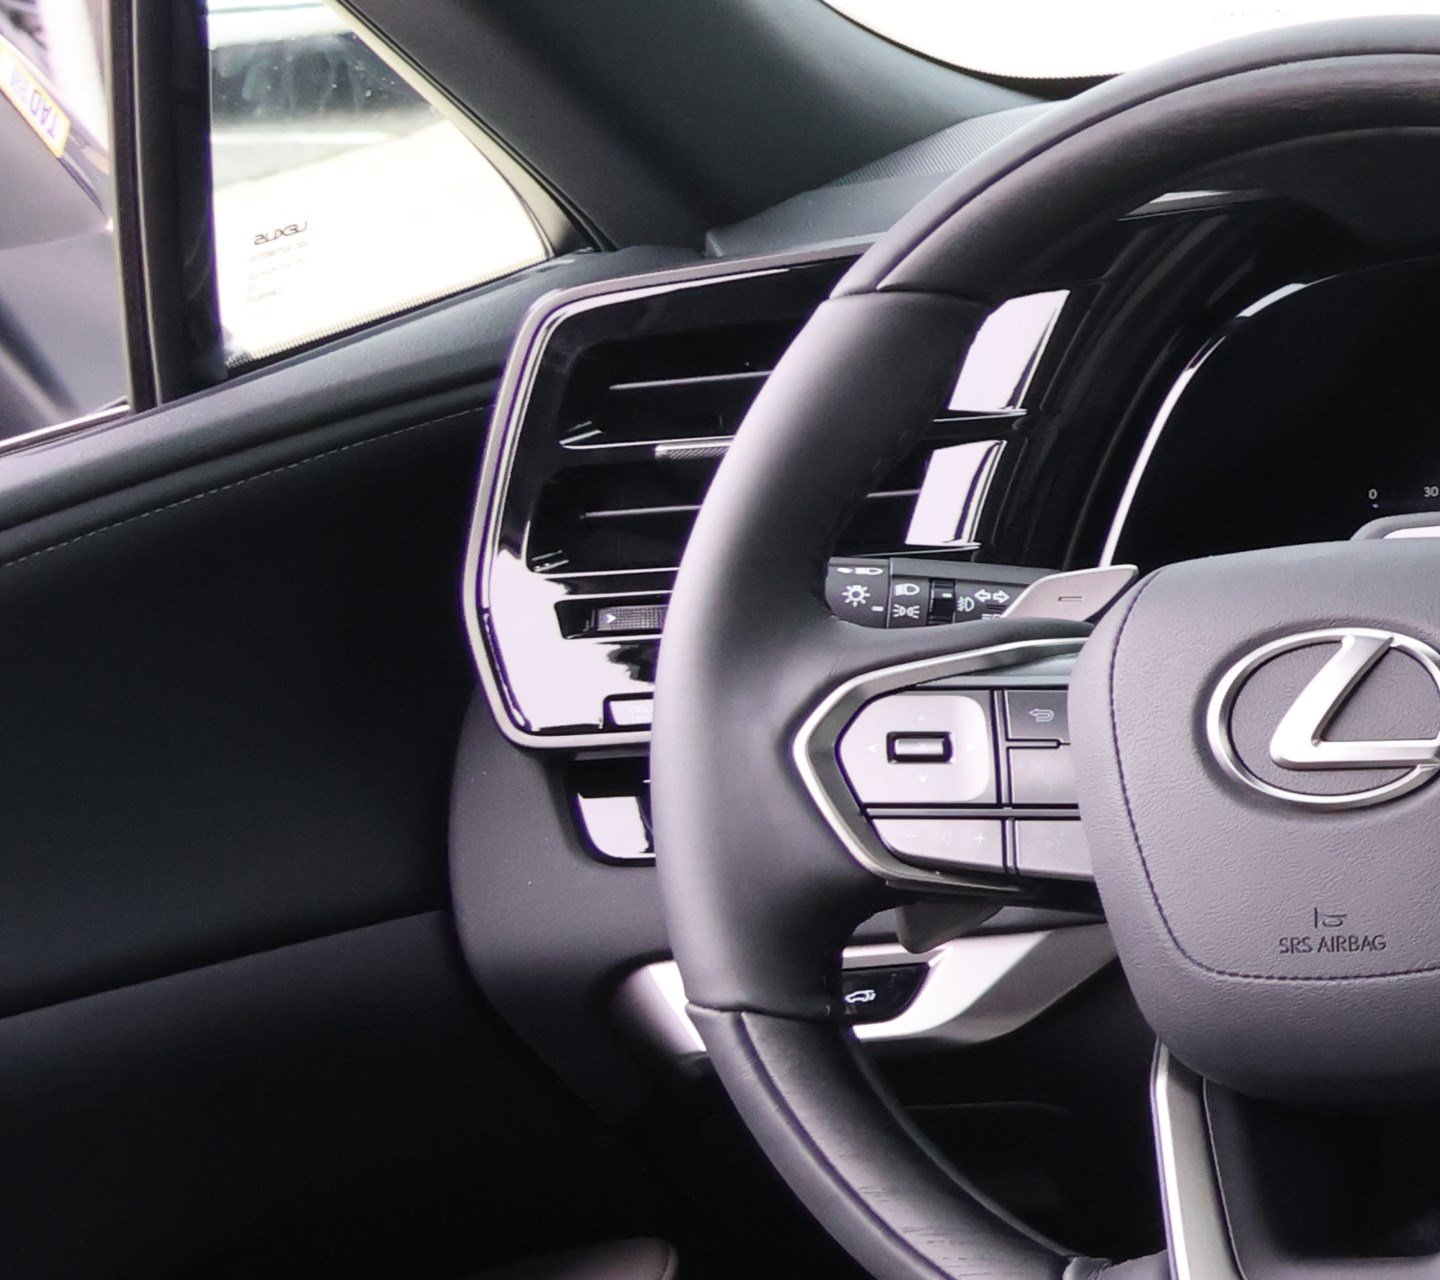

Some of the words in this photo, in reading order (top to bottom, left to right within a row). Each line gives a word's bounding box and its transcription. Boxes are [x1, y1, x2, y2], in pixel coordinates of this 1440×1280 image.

[1368, 488, 1378, 500] 0
[1423, 485, 1440, 498] 30
[1279, 936, 1312, 954] SRS
[1317, 934, 1387, 953] AIRBAG
